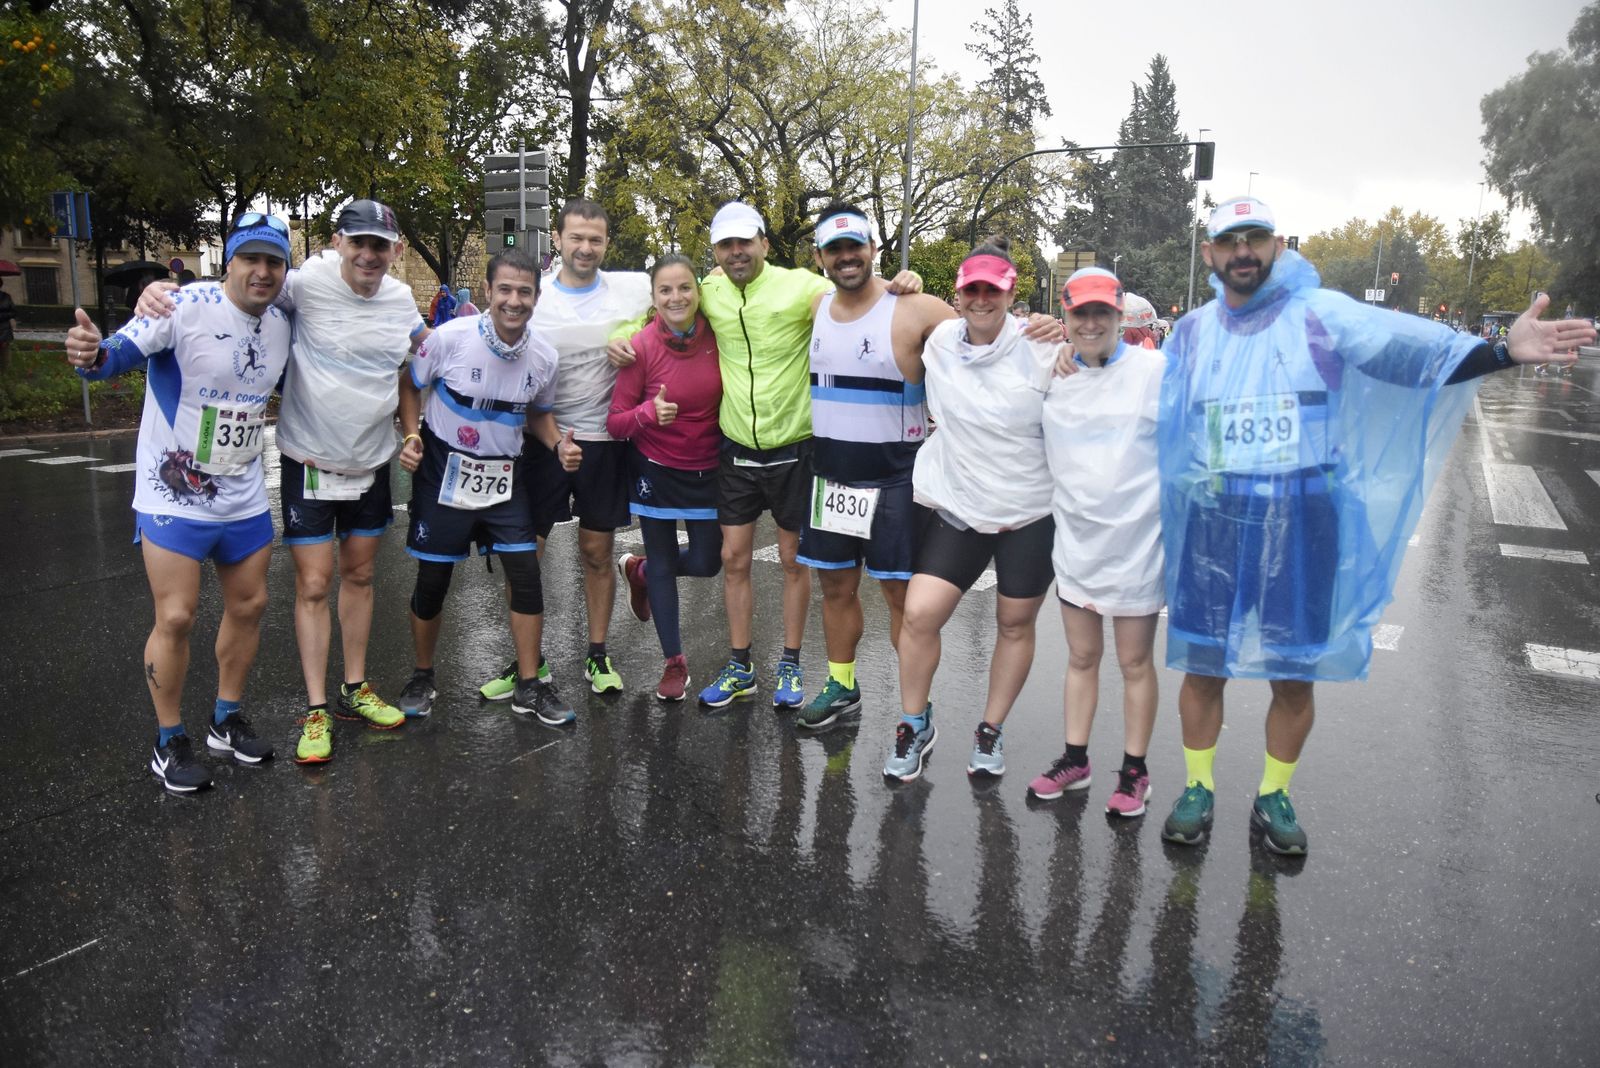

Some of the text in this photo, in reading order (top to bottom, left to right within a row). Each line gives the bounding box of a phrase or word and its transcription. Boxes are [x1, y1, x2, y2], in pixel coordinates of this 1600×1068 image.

[507, 235, 514, 246] 19
[217, 424, 262, 447] 3377
[1224, 416, 1292, 445] 4839
[461, 471, 508, 495] 7376
[825, 492, 868, 517] 4830
